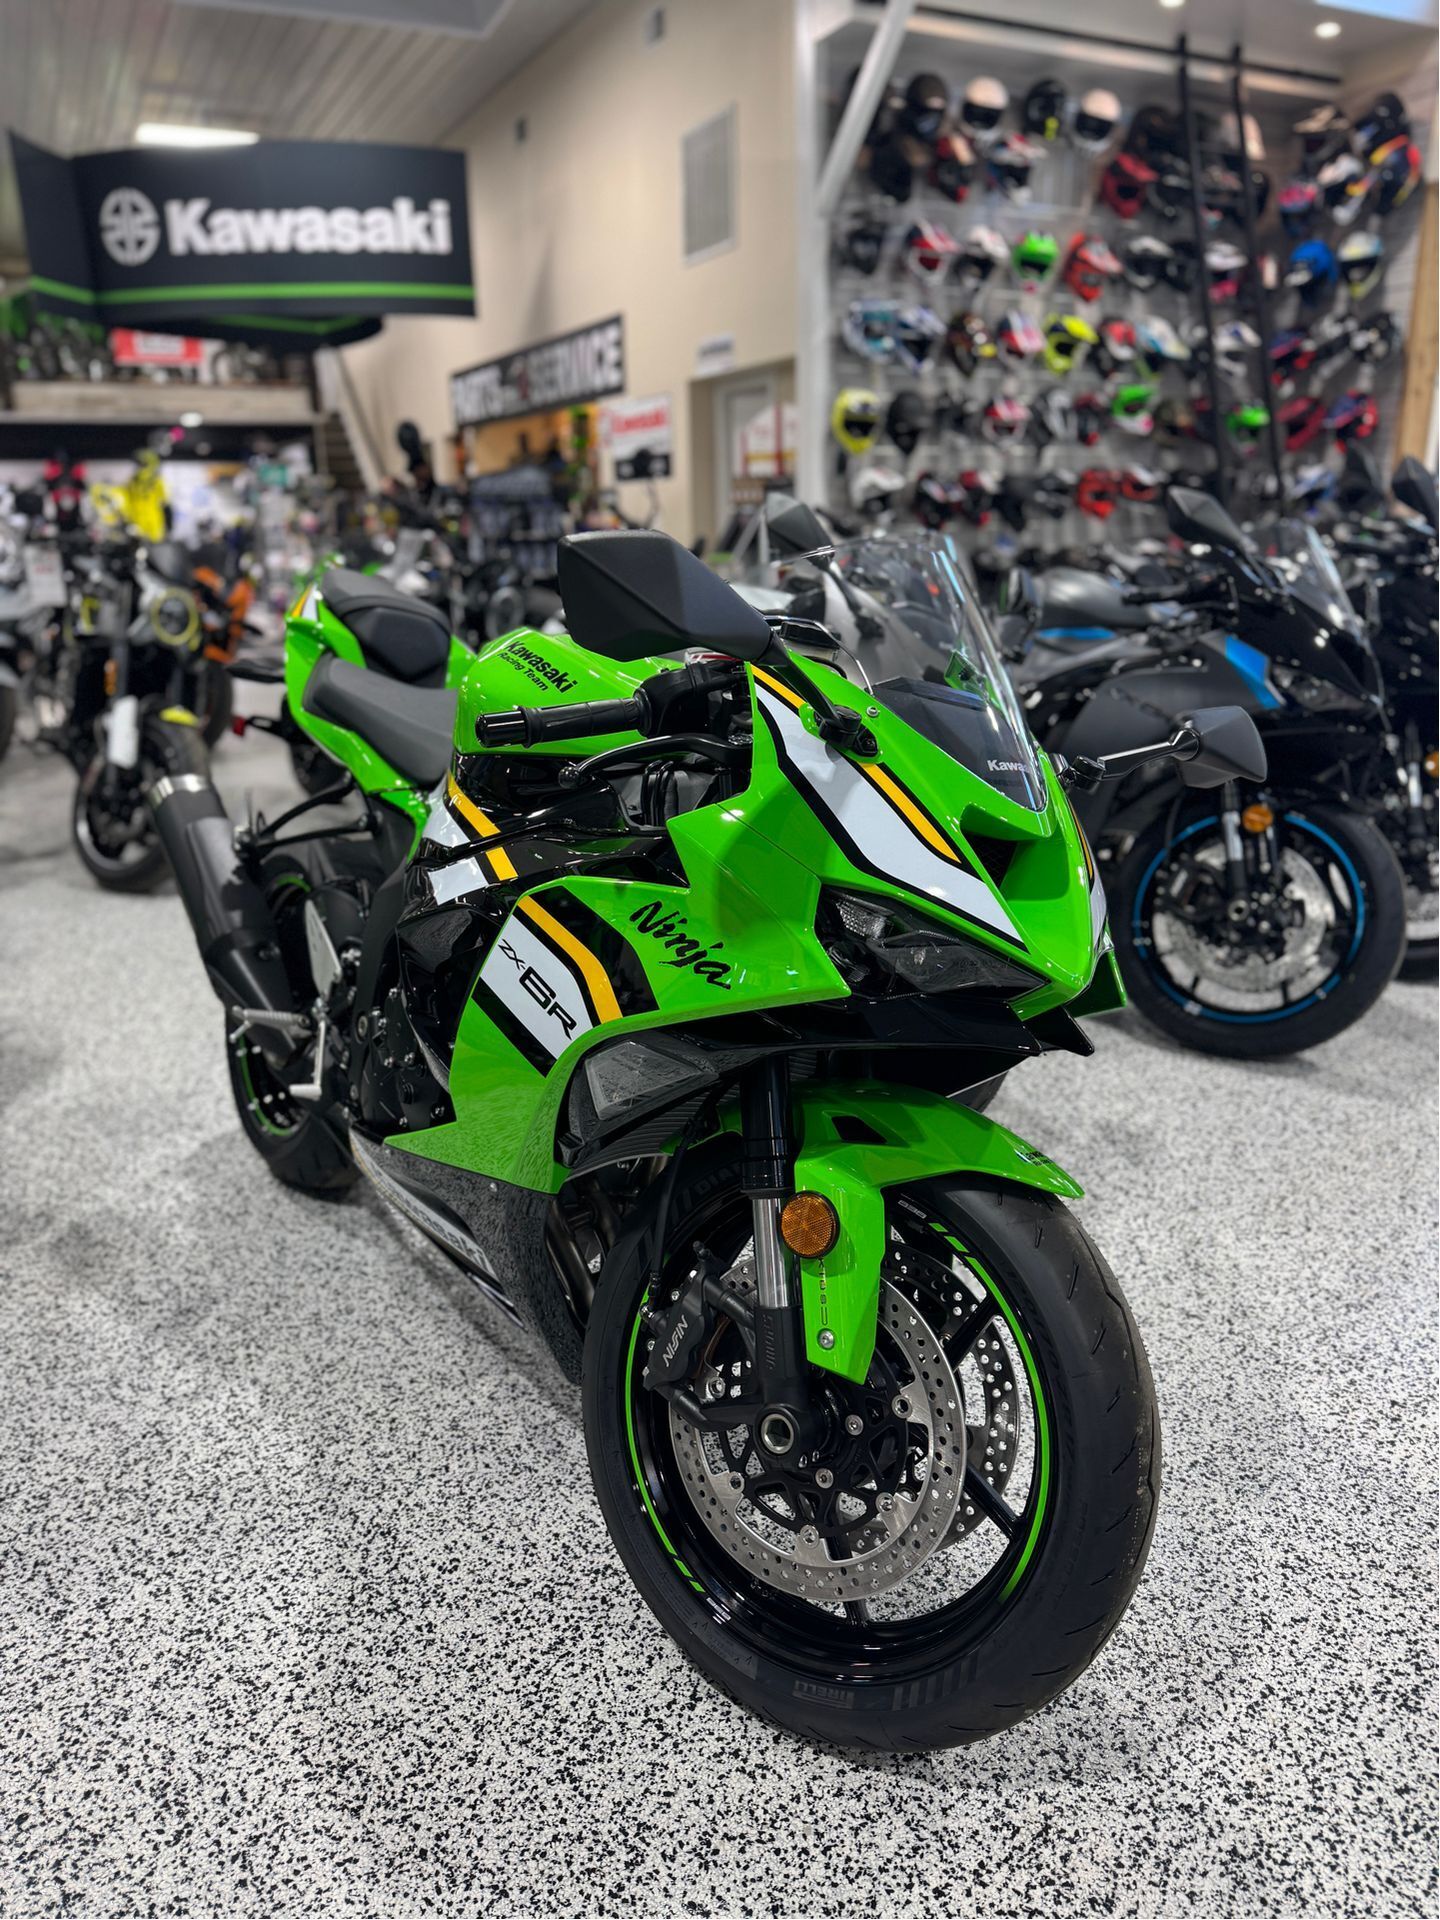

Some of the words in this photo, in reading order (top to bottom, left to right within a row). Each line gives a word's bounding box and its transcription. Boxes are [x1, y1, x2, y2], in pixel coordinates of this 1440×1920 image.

[165, 197, 452, 256] Kawasaki
[497, 652, 525, 671] Racing
[523, 668, 549, 691] Team
[504, 640, 578, 693] Kawasaki
[629, 900, 731, 990] Ninja
[498, 938, 577, 1041] ZX-6R
[662, 1314, 688, 1367] NISSIN
